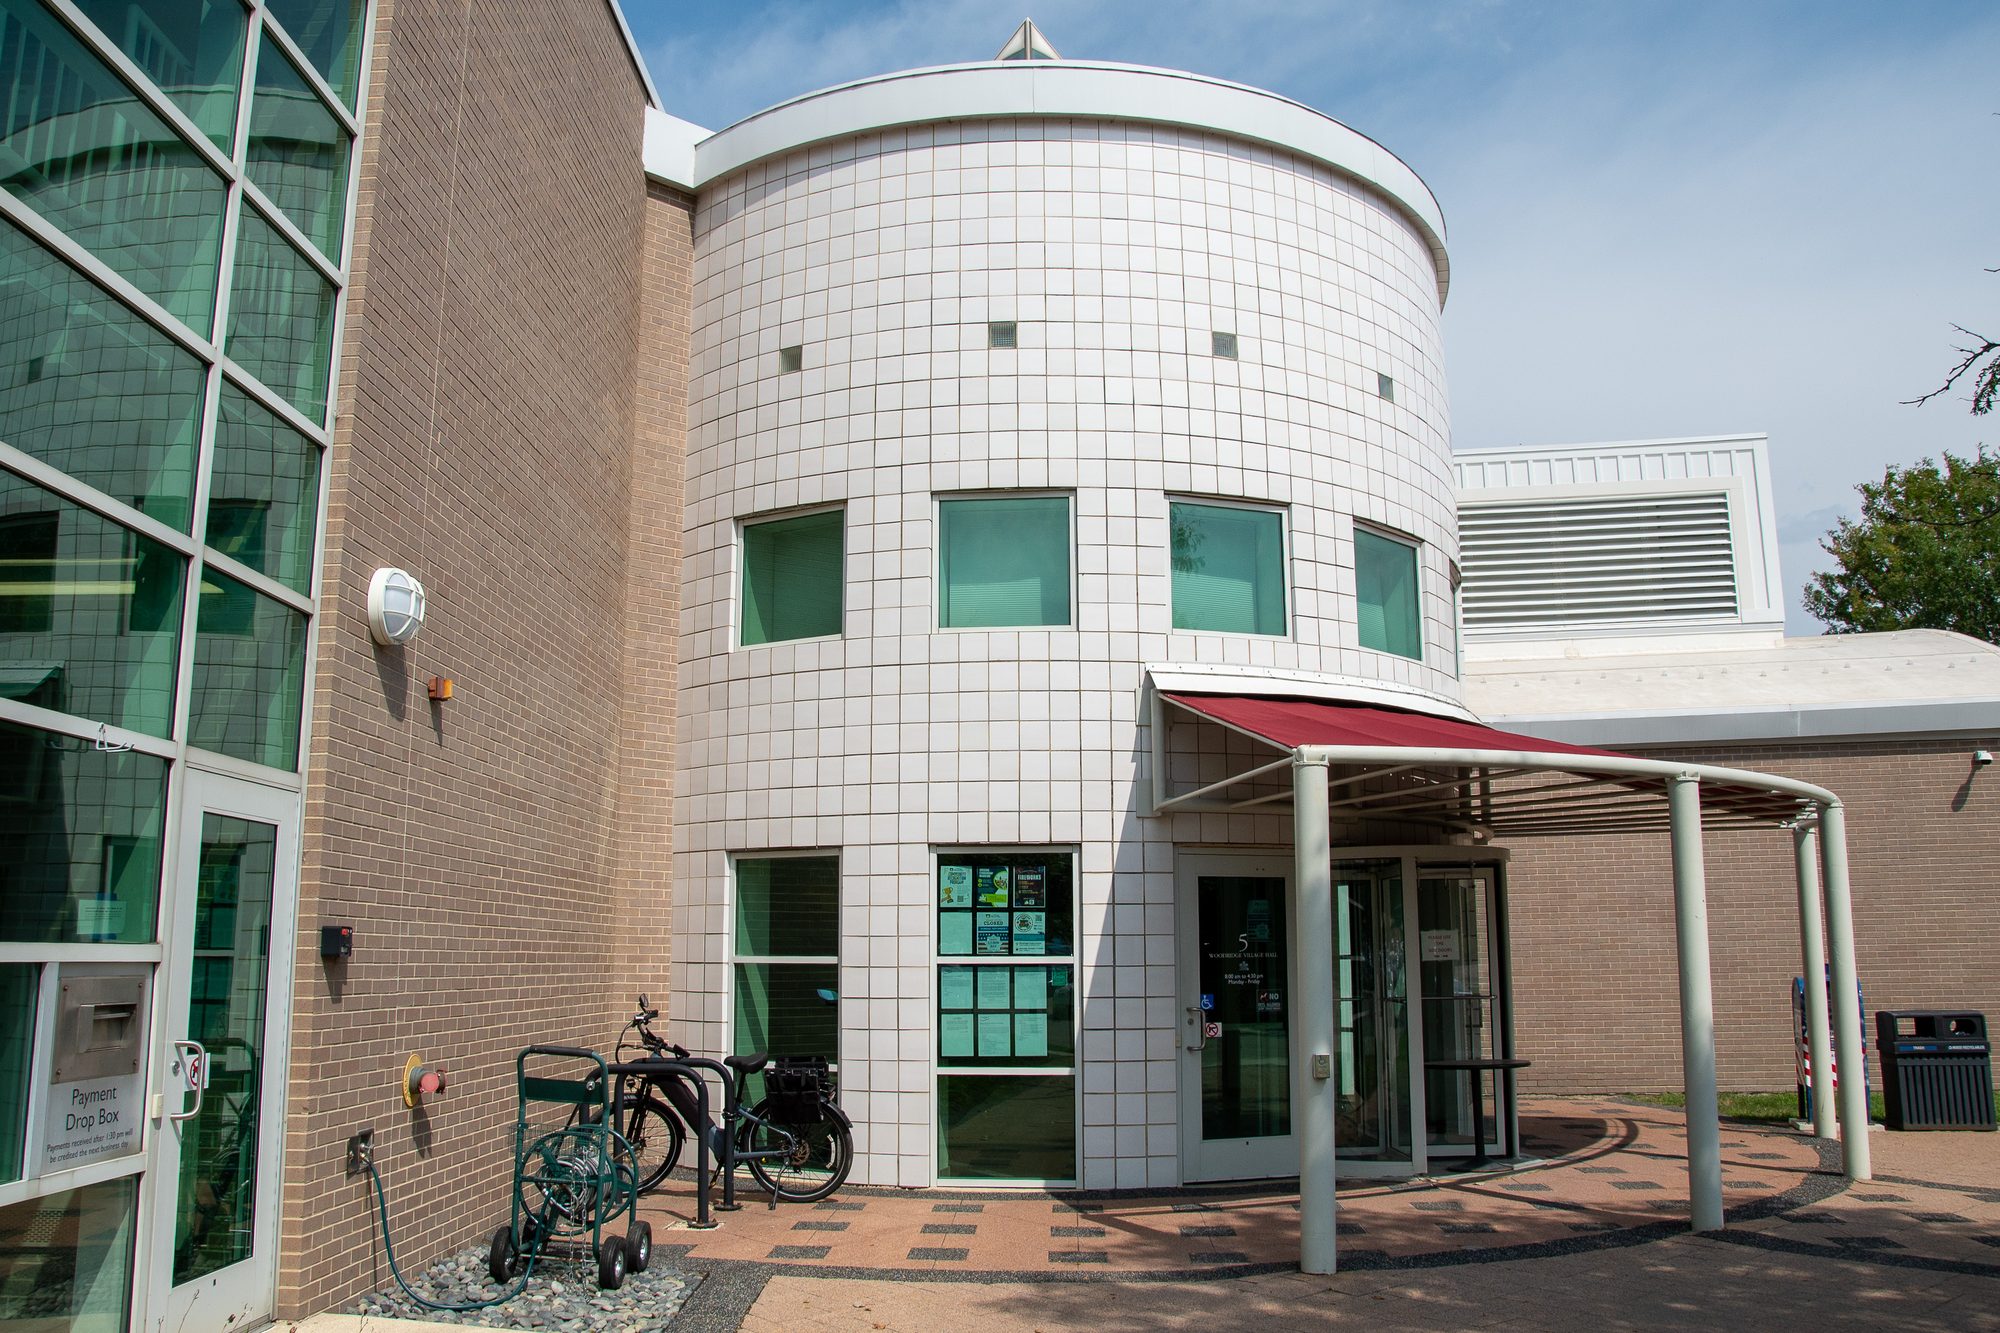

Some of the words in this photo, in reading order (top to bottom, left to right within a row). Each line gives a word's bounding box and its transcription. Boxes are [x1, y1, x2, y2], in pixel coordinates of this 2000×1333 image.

[1238, 933, 1249, 952] 5
[72, 1087, 117, 1109] Payment
[65, 1114, 95, 1132] Drop
[99, 1108, 120, 1125] Box
[47, 1141, 71, 1153] Payments
[71, 1137, 92, 1147] received
[93, 1135, 104, 1144] after
[106, 1131, 117, 1140] 1:30
[116, 1131, 124, 1140] pm
[125, 1128, 133, 1136] will
[49, 1155, 57, 1163] be
[57, 1150, 78, 1162] credited
[88, 1146, 100, 1154] next
[101, 1143, 120, 1152] business
[121, 1140, 129, 1150] day
